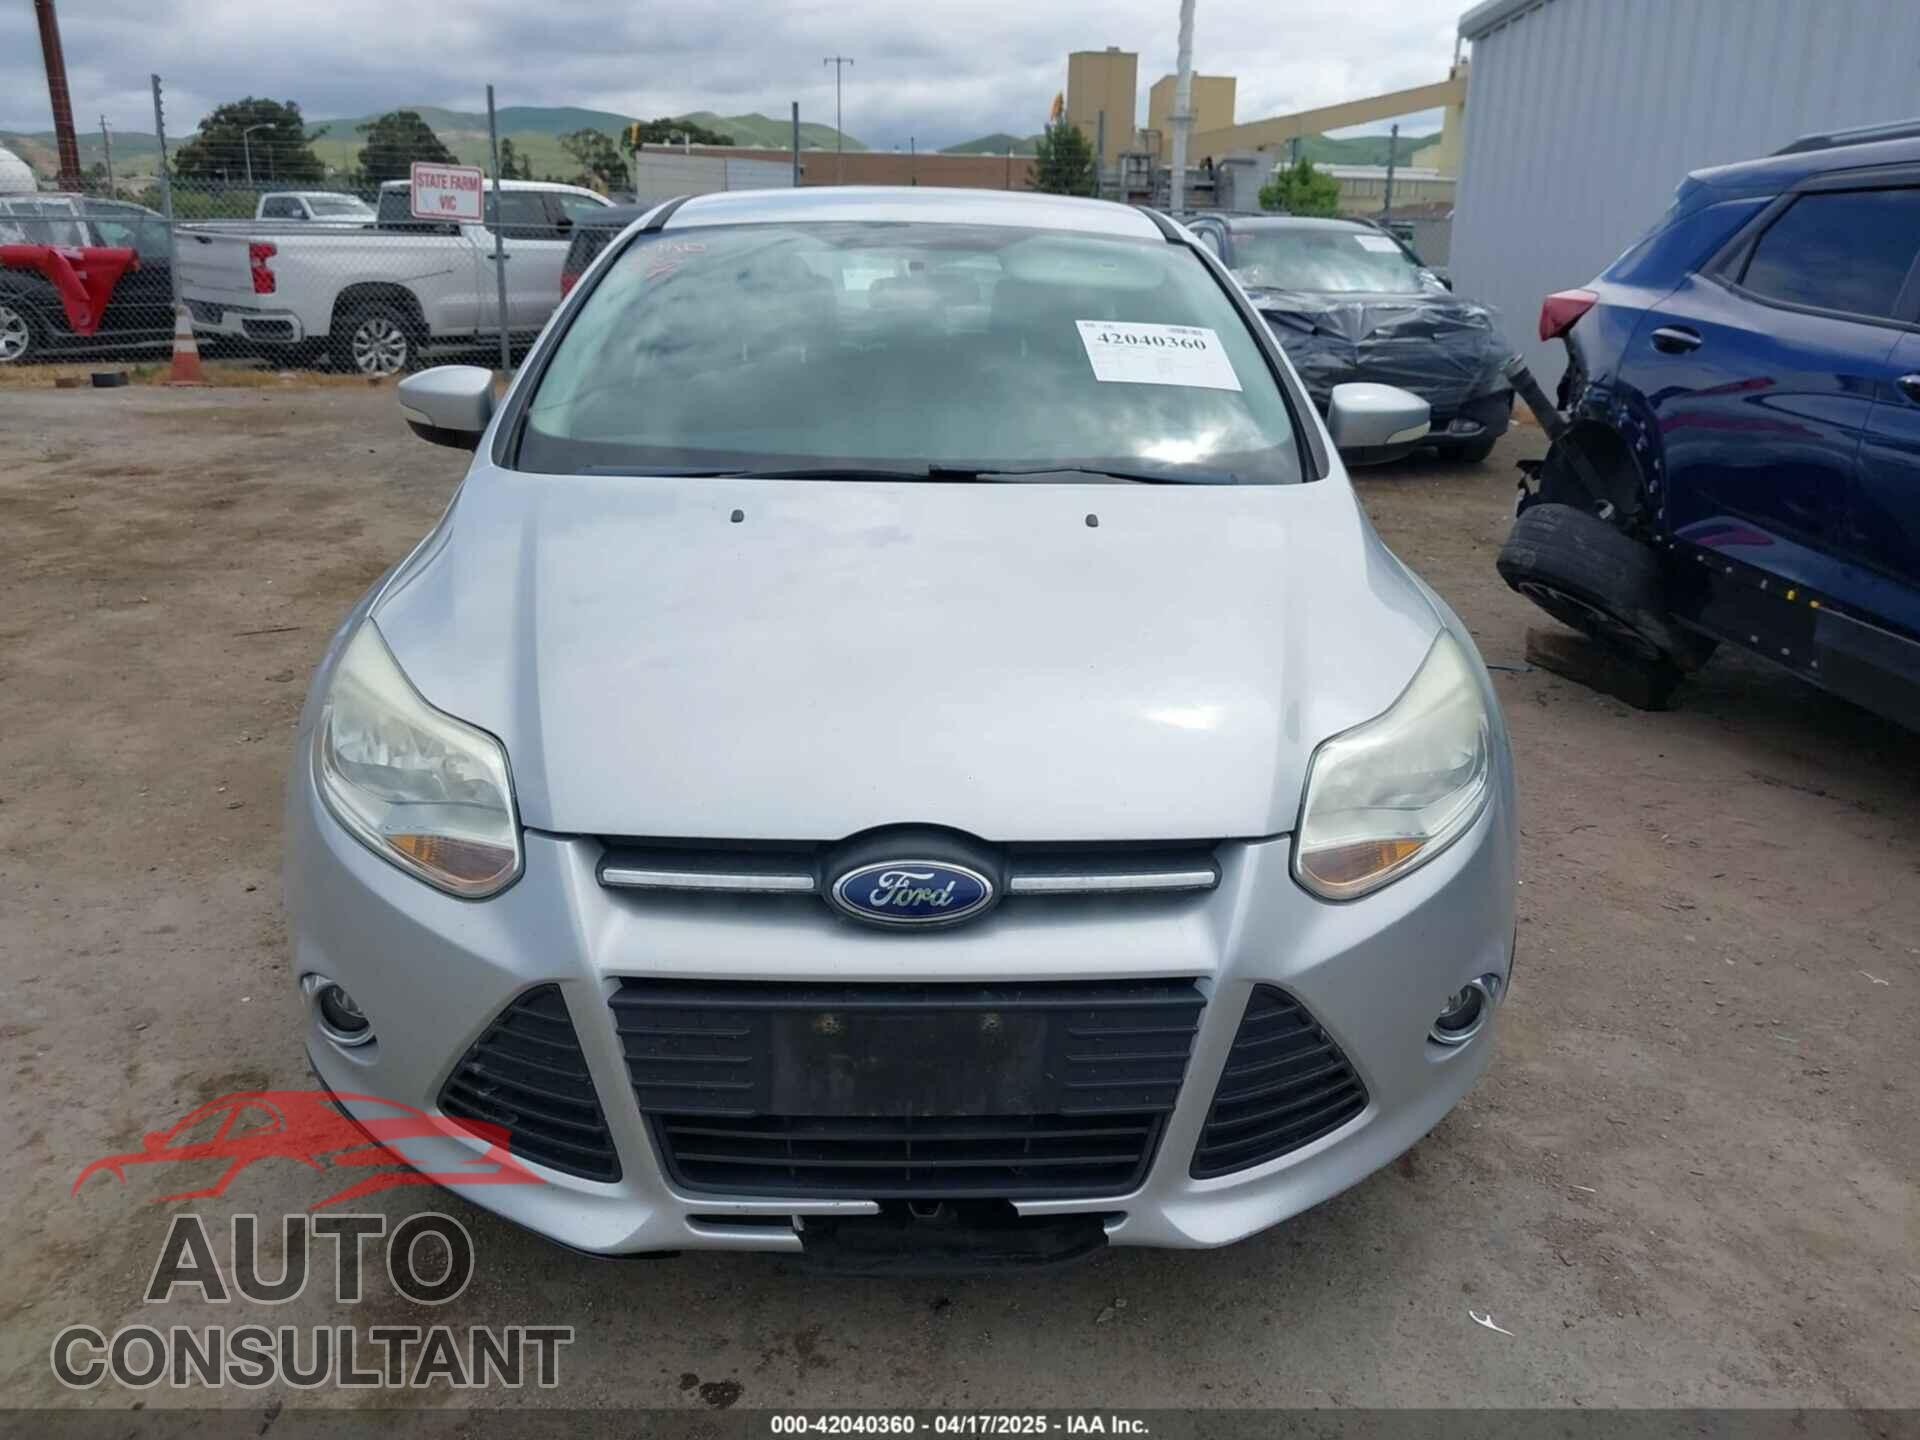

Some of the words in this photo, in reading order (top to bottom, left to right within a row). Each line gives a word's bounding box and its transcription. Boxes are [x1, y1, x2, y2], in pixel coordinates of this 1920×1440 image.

[416, 173, 447, 189] STATE
[450, 175, 478, 191] FARM
[439, 195, 457, 210] VIC
[1097, 332, 1207, 351] 42040360
[869, 870, 956, 907] Ford
